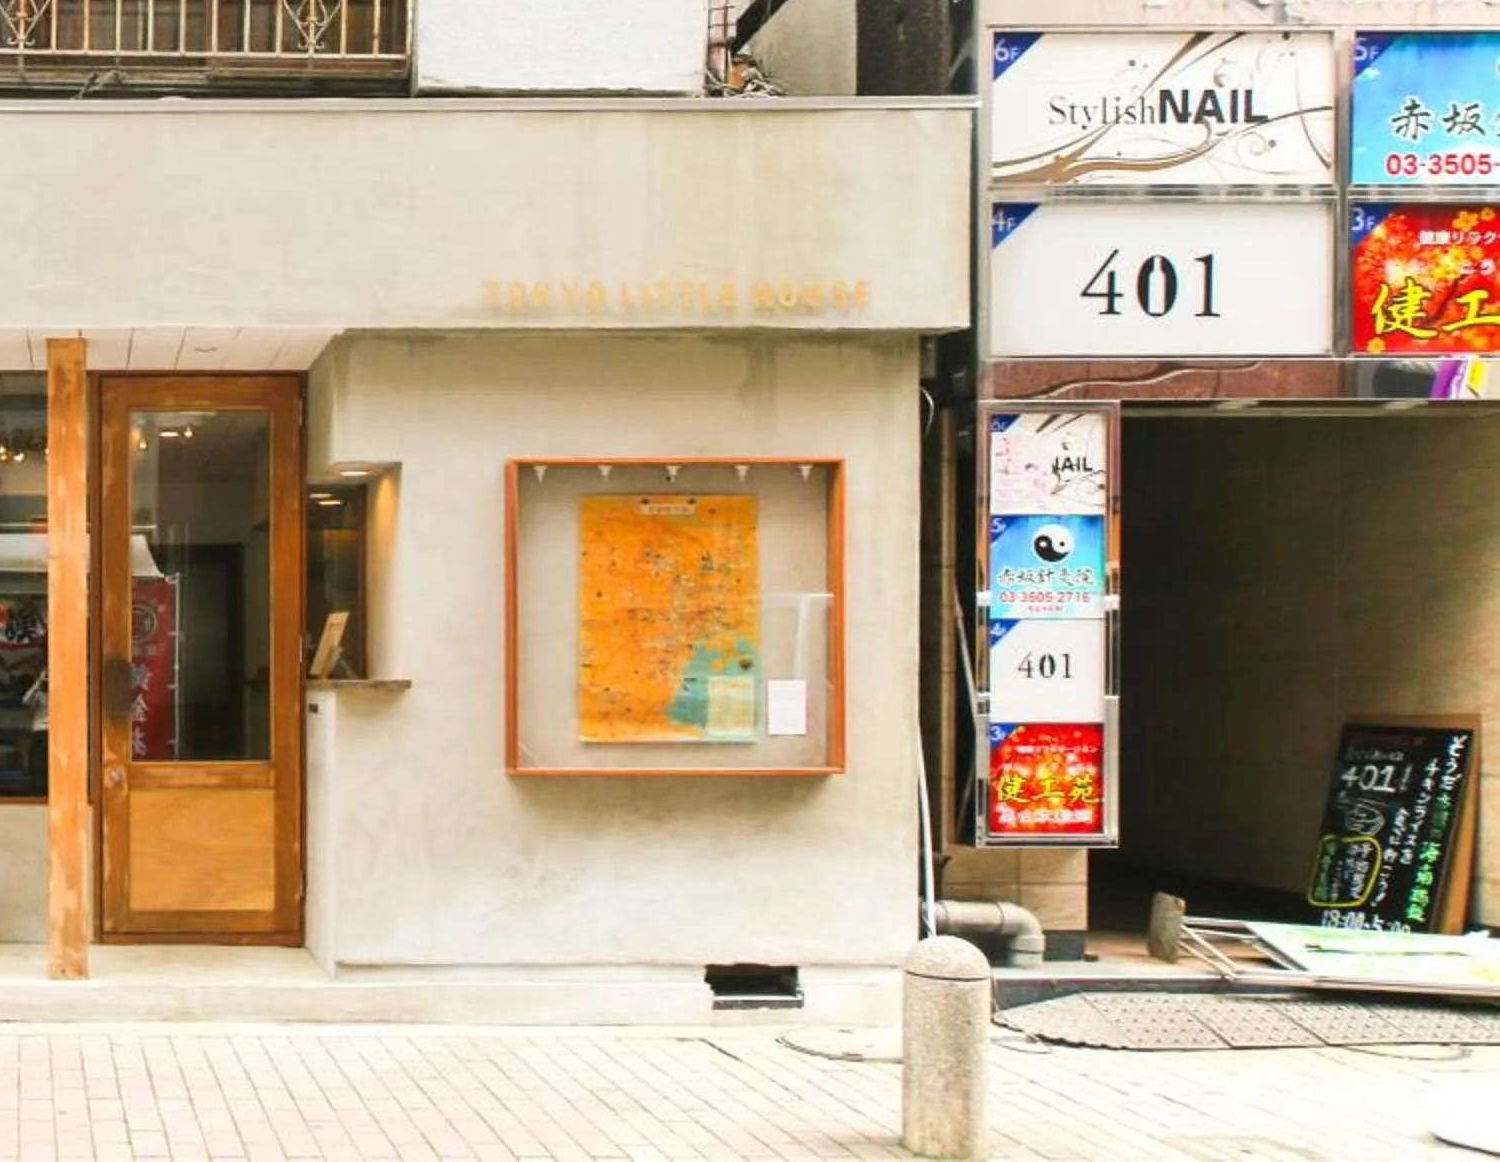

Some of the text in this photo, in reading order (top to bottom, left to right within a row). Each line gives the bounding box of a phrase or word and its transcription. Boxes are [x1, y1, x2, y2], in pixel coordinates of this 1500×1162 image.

[994, 41, 1020, 63] 6F
[1391, 97, 1500, 140] 赤坂
[992, 209, 1017, 232] 4F
[1352, 207, 1377, 231] 3F
[483, 278, 872, 313] TOKYO LITTLE HOUSE
[1079, 248, 1222, 318] 401
[1017, 652, 1073, 679] 401
